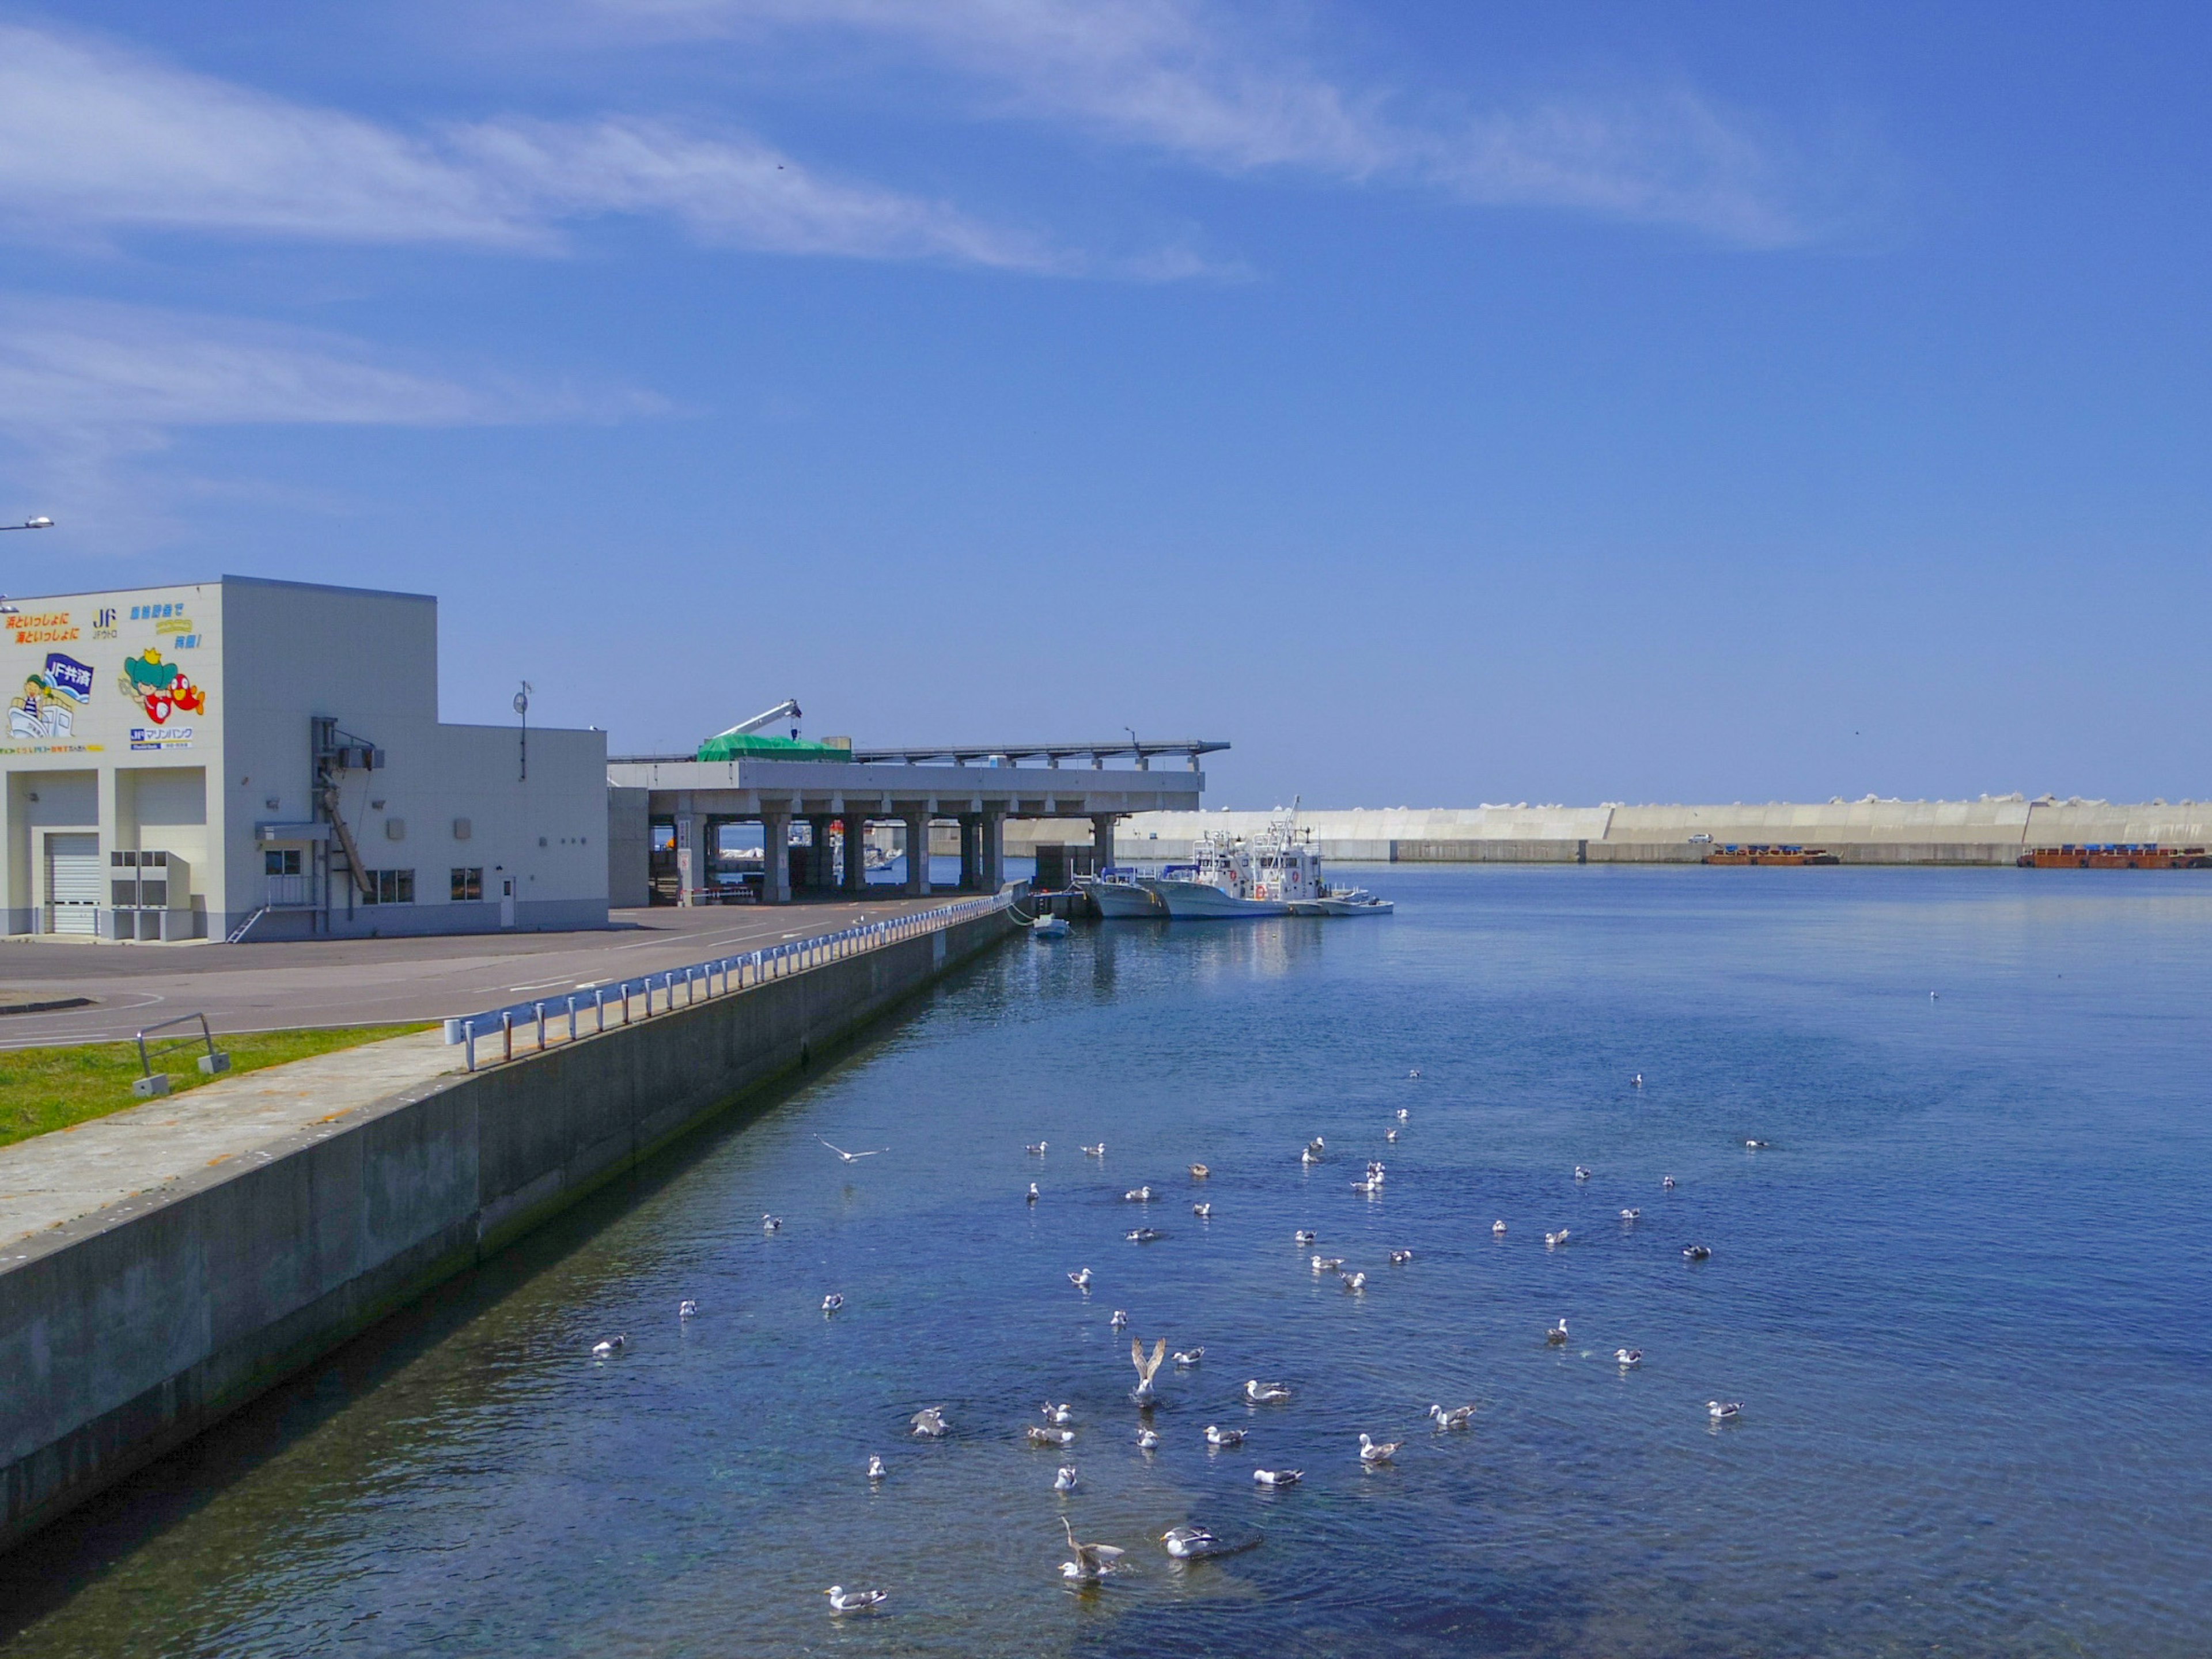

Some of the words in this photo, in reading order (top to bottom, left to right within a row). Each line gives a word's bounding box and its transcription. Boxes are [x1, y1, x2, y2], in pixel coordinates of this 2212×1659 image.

[5, 613, 69, 629] 浜といっしょに
[15, 628, 79, 644] 海といっしょに
[45, 661, 91, 687] JF共済
